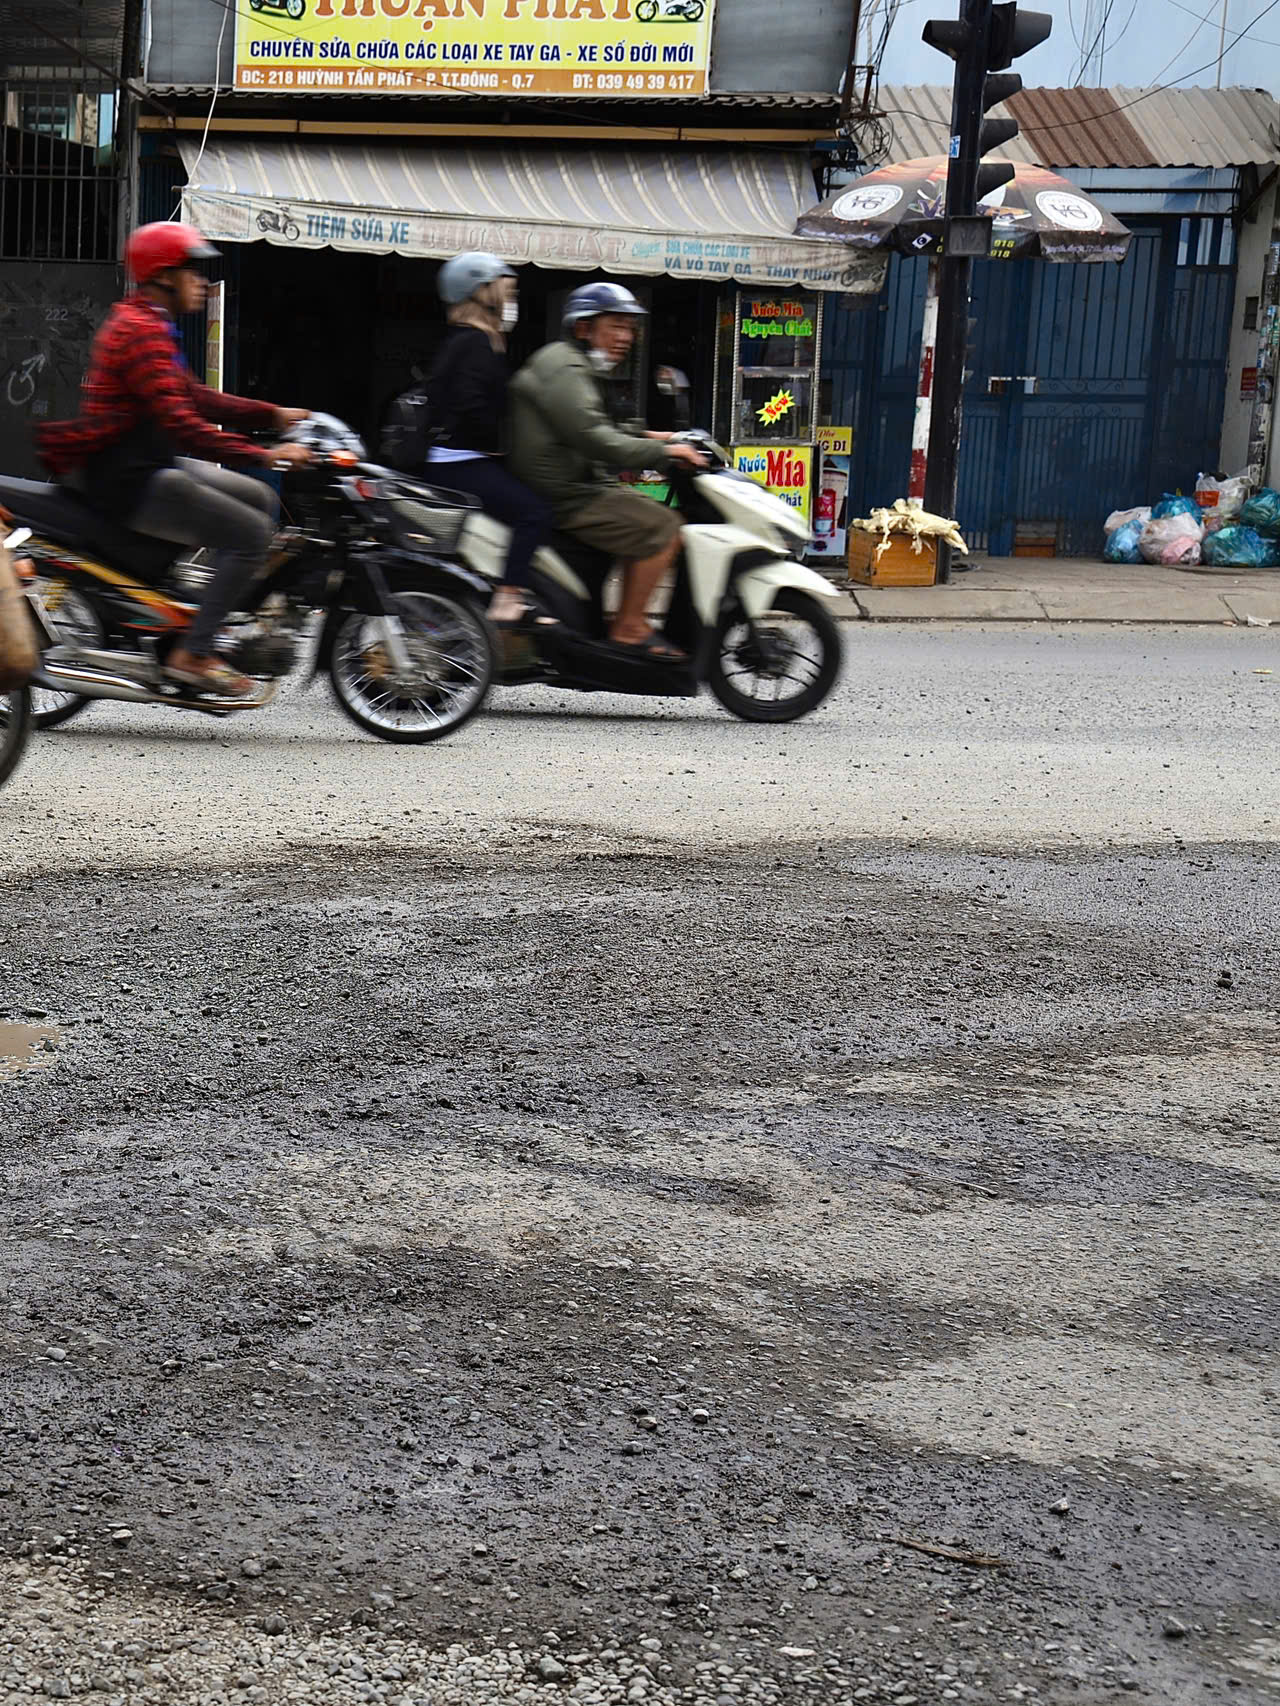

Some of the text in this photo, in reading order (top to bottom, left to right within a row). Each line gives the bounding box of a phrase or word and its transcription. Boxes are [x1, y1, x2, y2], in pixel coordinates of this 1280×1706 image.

[250, 37, 314, 58] CHUYÊN
[319, 37, 351, 59] SỬA
[356, 40, 399, 60] CHỮA
[404, 40, 437, 60] CÁC
[442, 43, 477, 64] LOẠI
[483, 44, 502, 61] XE
[509, 44, 534, 62] TAY
[540, 45, 561, 62] GA
[578, 46, 597, 62] XE
[603, 40, 626, 62] SỐ
[630, 42, 656, 63] ĐỜI
[662, 43, 694, 63] MỚI
[242, 70, 264, 84] ĐC:
[268, 70, 293, 85] 218
[297, 69, 344, 86] HUỲNH
[347, 67, 374, 86] TẤN
[377, 69, 415, 87] PHÁT
[512, 74, 535, 88] Q.7
[573, 74, 695, 90] ĐT: 039 49 39 417
[306, 212, 345, 243] TIỆM
[389, 221, 410, 244] XE
[708, 260, 730, 273] TAY
[767, 265, 800, 279] THAY
[737, 449, 805, 488] Nước Mía
